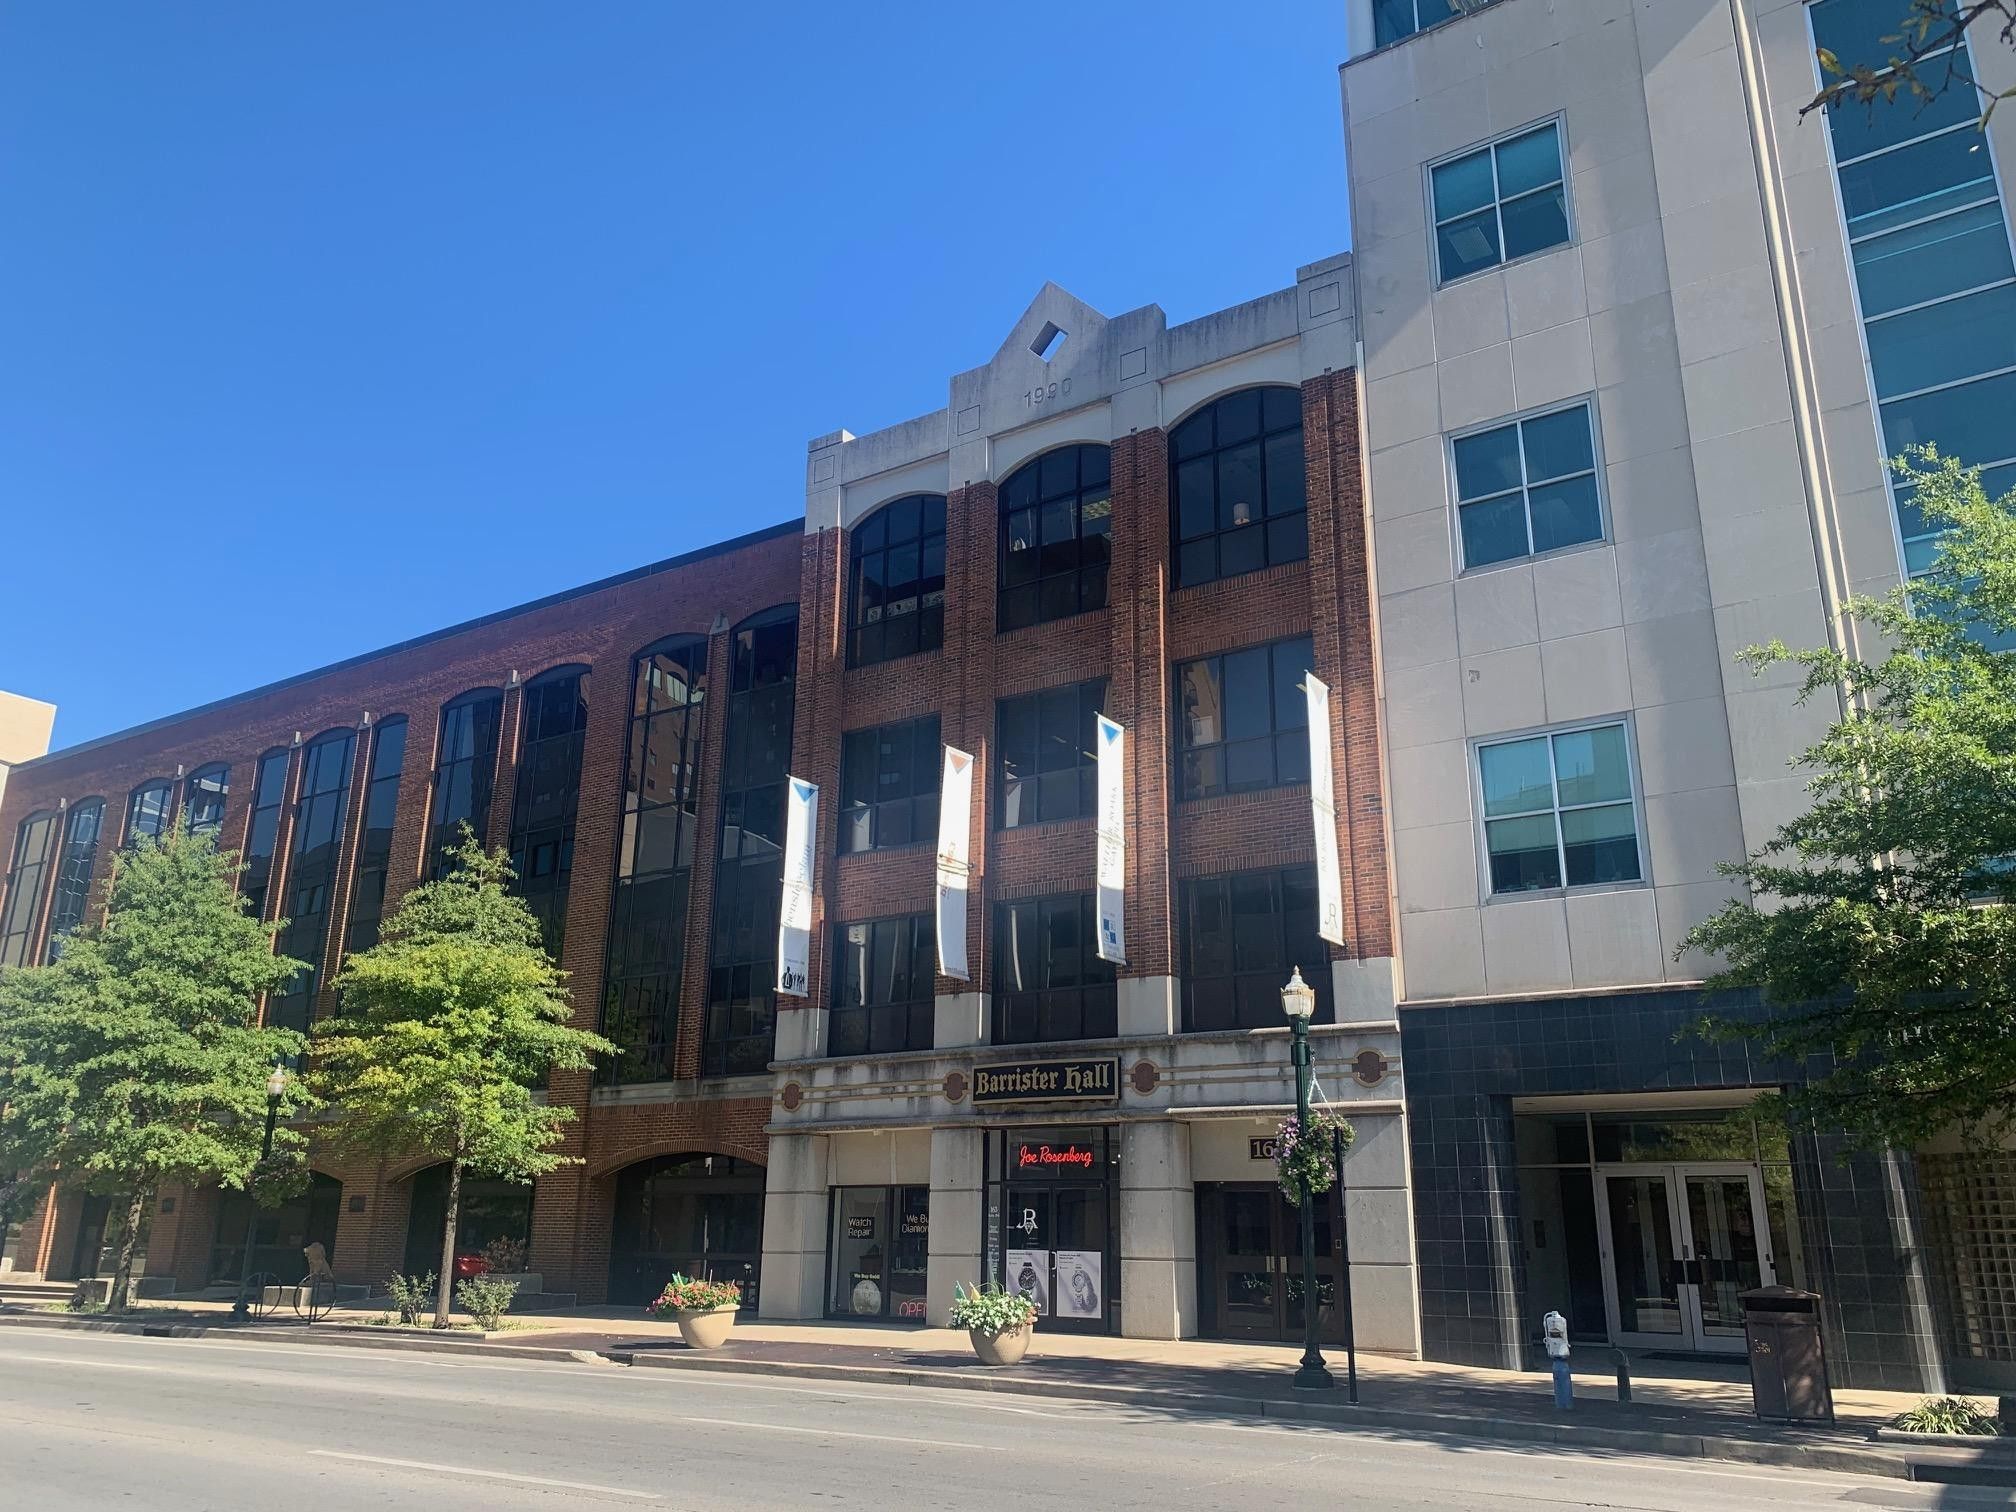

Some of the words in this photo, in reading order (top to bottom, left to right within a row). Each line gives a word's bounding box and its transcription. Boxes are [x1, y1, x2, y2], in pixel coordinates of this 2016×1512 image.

[1024, 377, 1072, 408] 1990
[976, 1068, 1058, 1095] Barrister
[1064, 1064, 1109, 1093] Hall
[1019, 1145, 1038, 1167] Joe
[1039, 1145, 1093, 1168] Rosenberg
[1253, 1141, 1275, 1158] 16
[848, 1218, 871, 1227] Watch
[906, 1214, 919, 1224] We
[919, 1213, 929, 1224] Bu
[848, 1227, 871, 1239] Repair
[901, 1223, 928, 1234] Diamon
